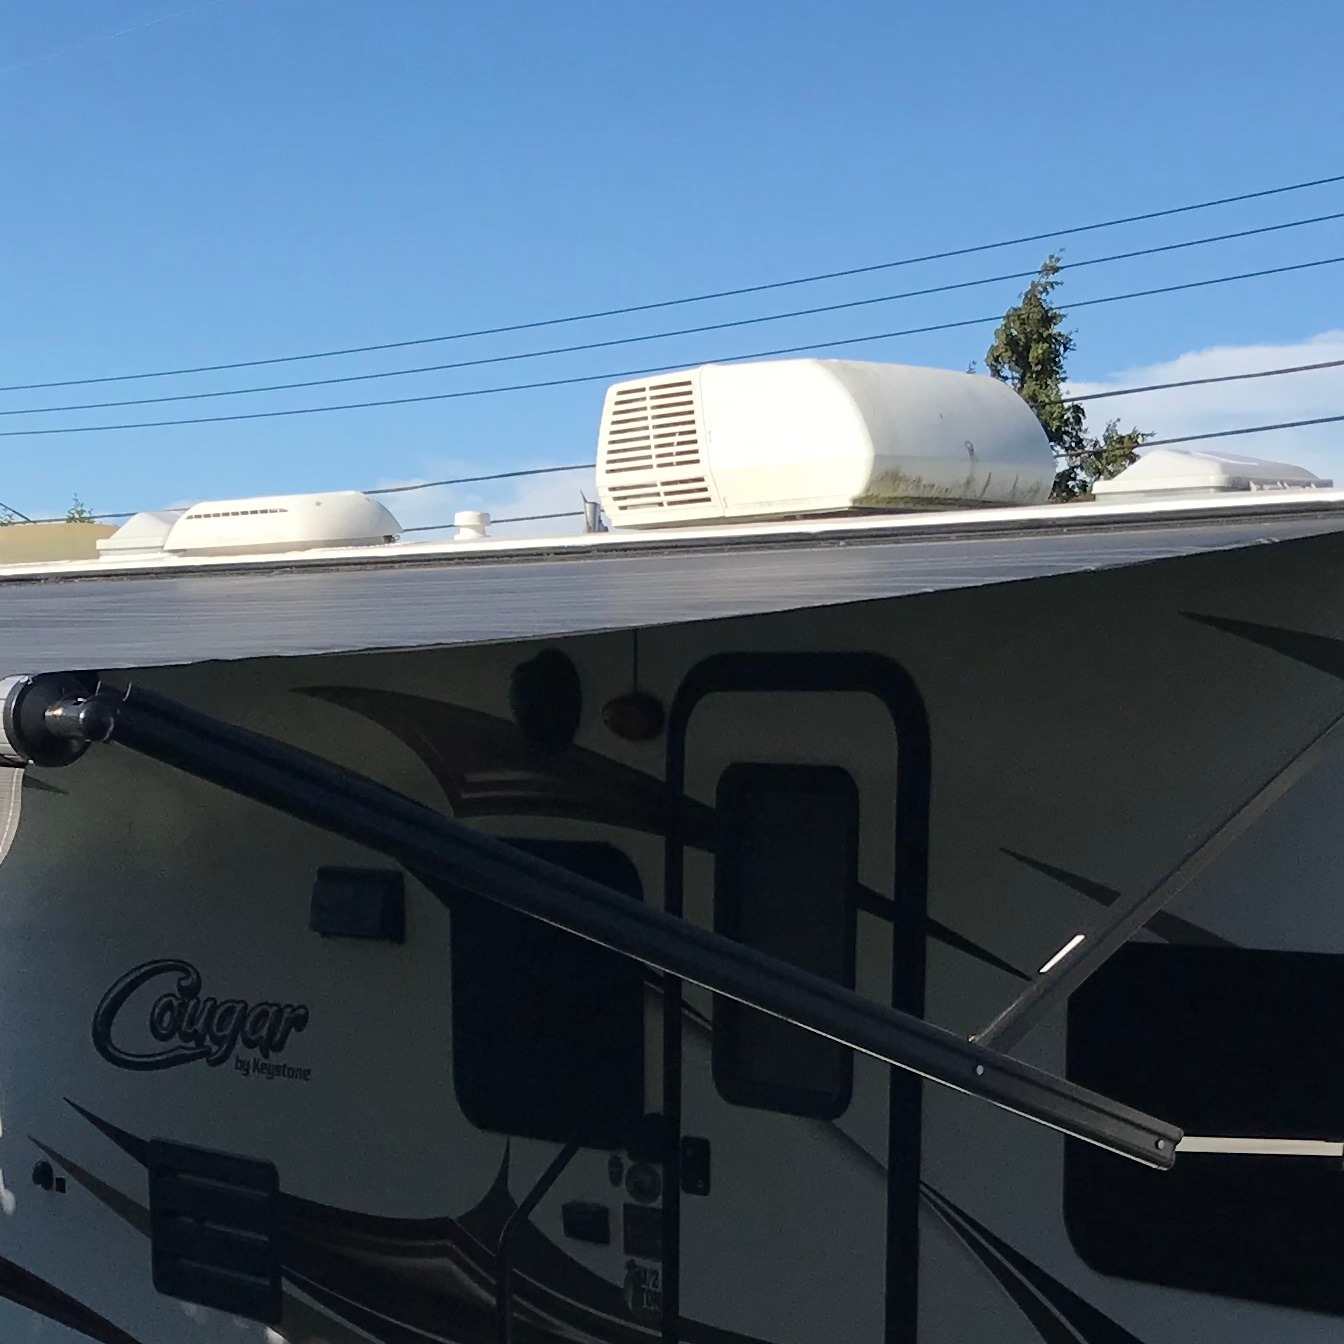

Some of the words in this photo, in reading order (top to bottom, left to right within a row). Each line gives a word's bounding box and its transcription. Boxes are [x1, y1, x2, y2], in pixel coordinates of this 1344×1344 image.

[92, 958, 309, 1071] Cougar
[234, 1055, 250, 1077] by
[252, 1057, 311, 1081] Keystone
